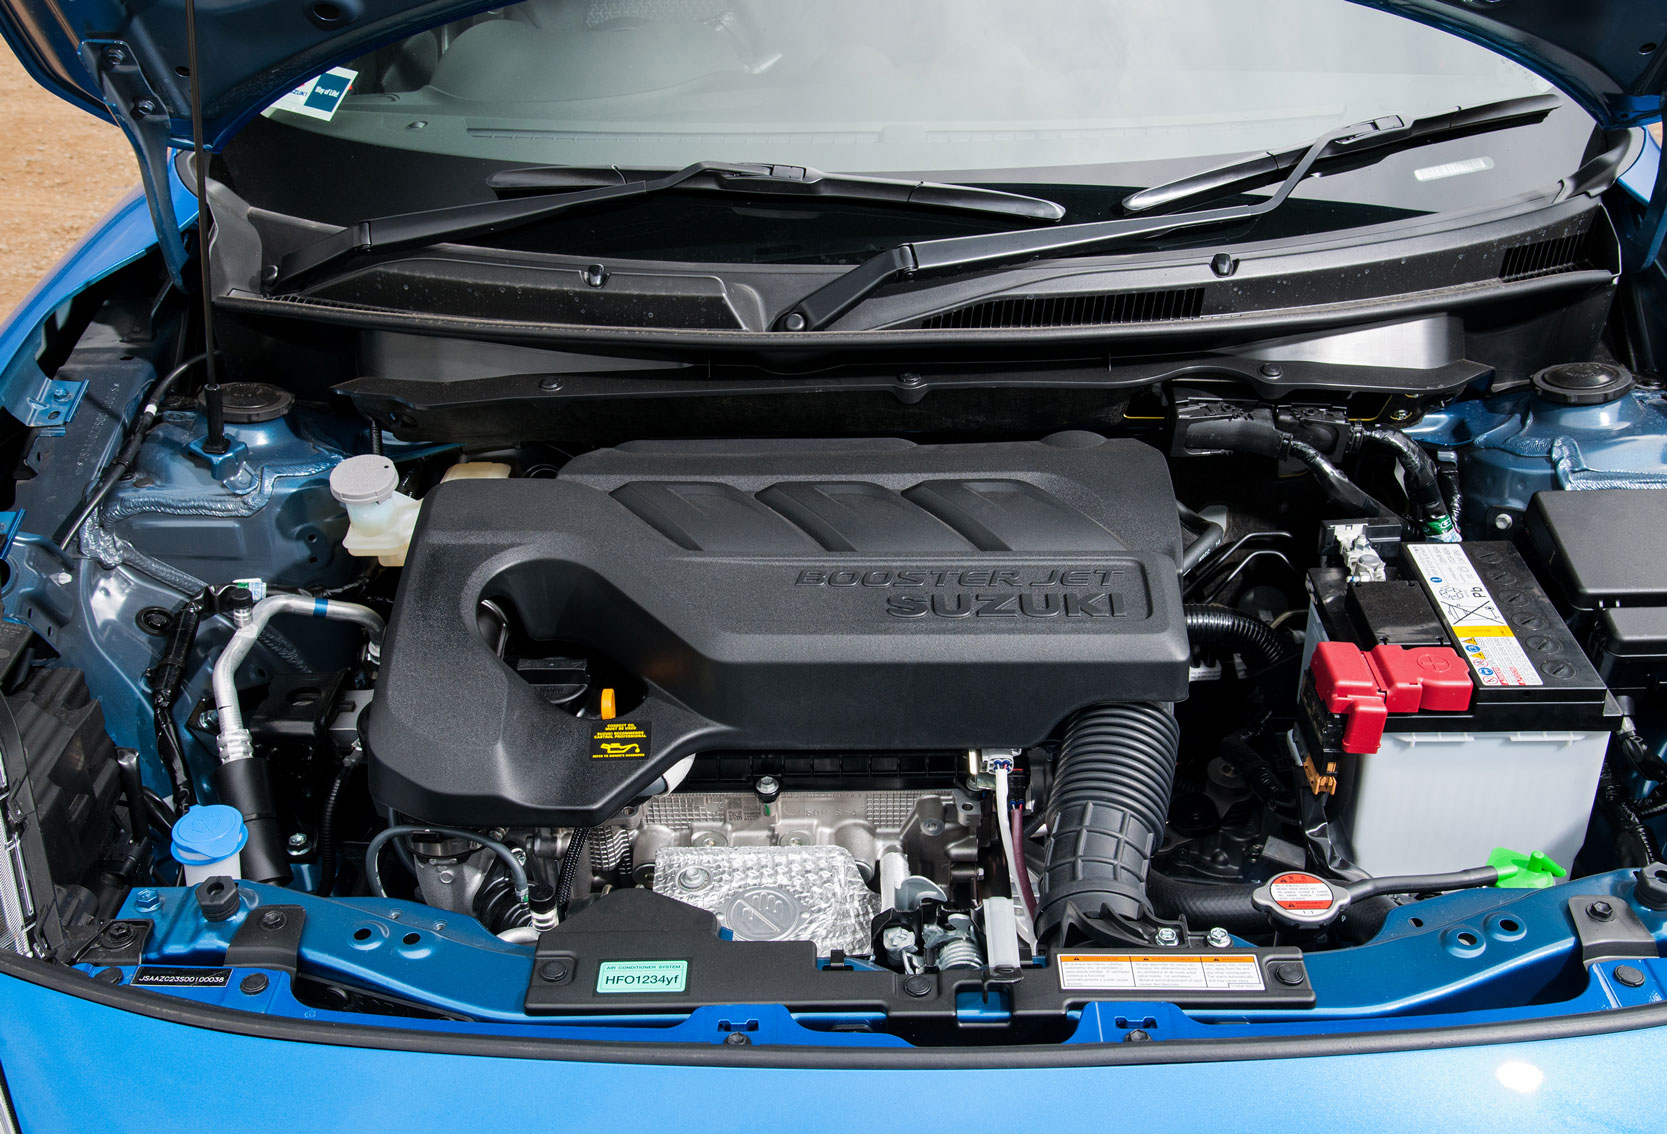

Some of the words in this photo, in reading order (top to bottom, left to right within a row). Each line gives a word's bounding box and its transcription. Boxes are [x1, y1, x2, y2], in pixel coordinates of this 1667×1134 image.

[1472, 586, 1486, 598] Pb
[886, 592, 1128, 618] SUZUKI
[605, 974, 679, 986] HFO1234yf
